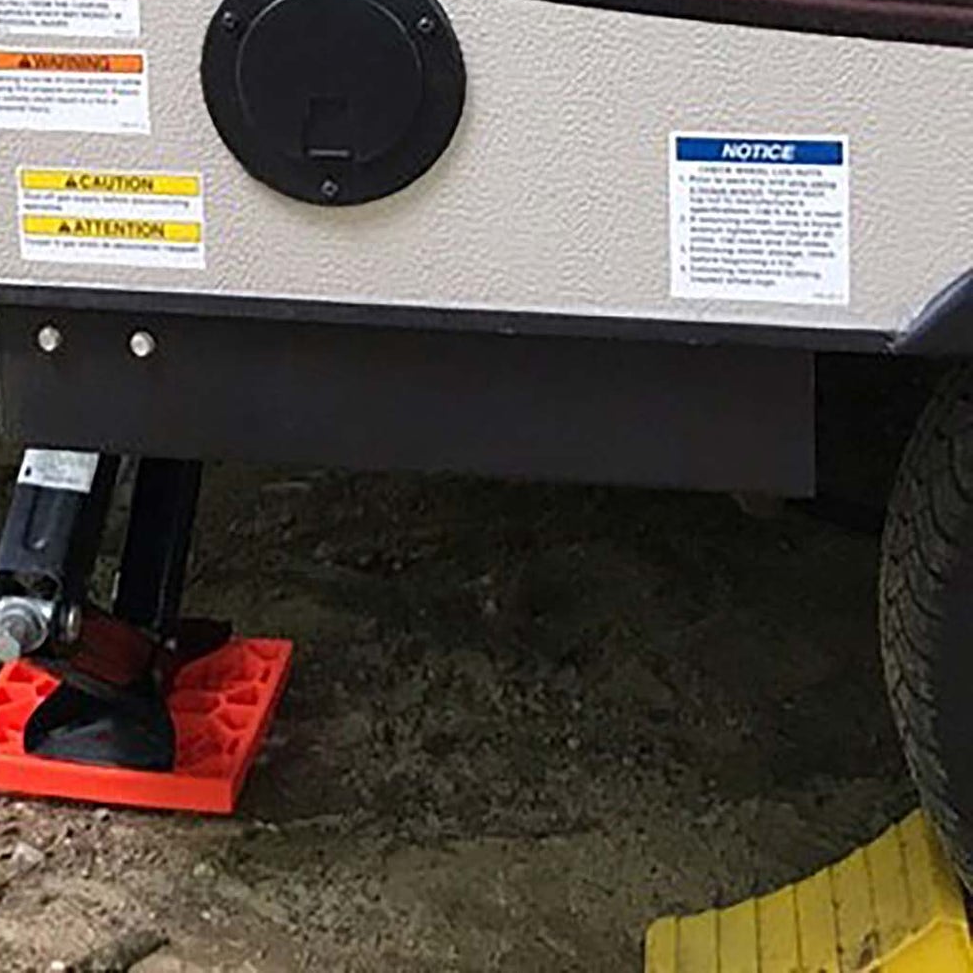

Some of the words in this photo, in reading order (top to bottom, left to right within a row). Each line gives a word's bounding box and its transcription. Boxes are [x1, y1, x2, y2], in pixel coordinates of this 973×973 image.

[34, 54, 110, 72] WARNING
[721, 142, 797, 161] NOTICE
[79, 174, 154, 192] CAUTION
[73, 219, 165, 239] ATTENTION
